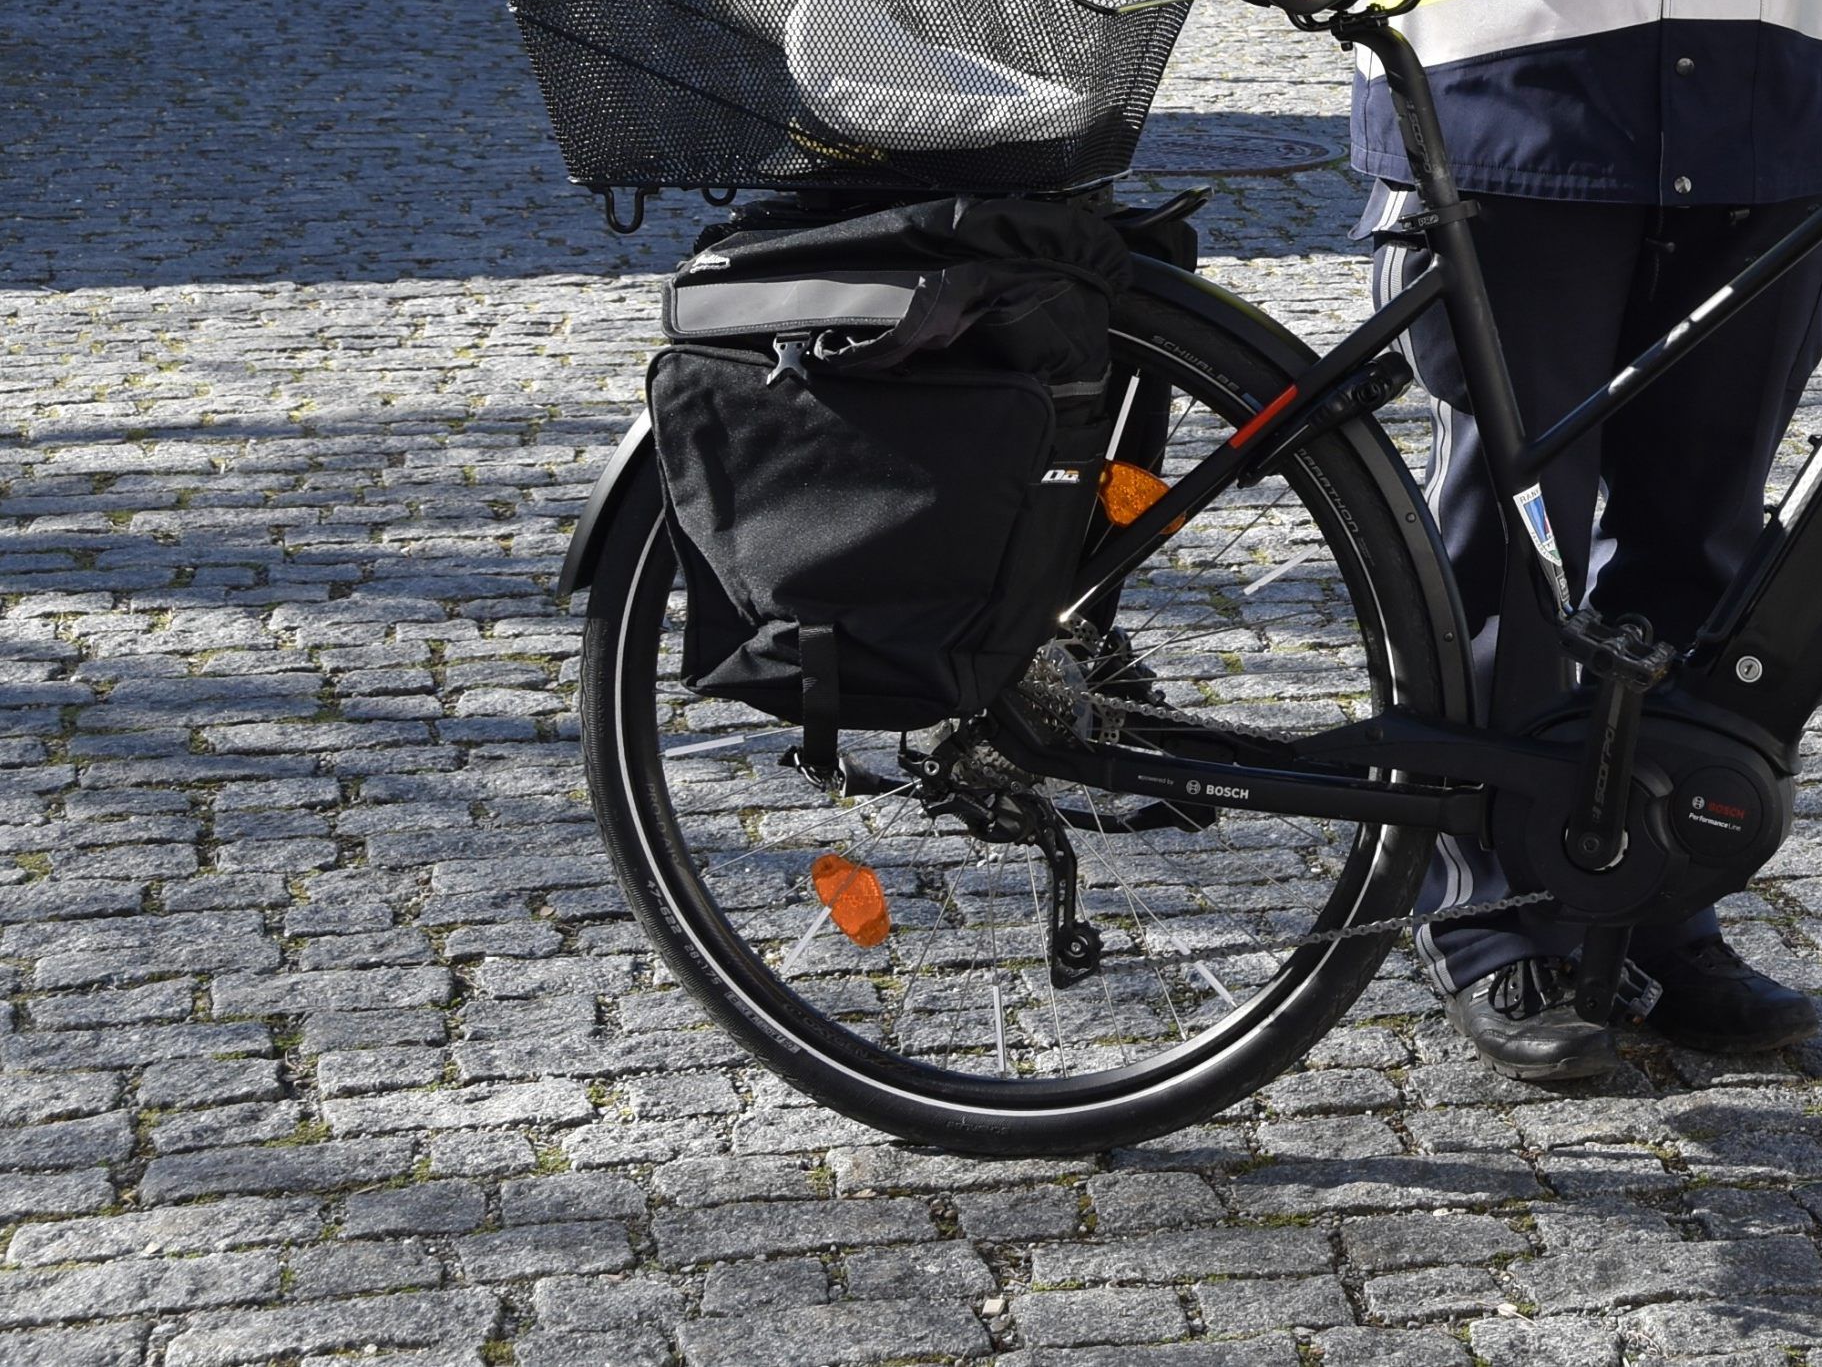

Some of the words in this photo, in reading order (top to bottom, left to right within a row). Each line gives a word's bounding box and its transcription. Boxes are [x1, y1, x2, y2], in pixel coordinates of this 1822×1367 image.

[1151, 334, 1241, 392] SCHWALBE
[1206, 784, 1250, 800] BOSCH
[1688, 812, 1729, 829] Performance
[1706, 800, 1745, 821] BOSCH
[647, 879, 683, 935] 47-622
